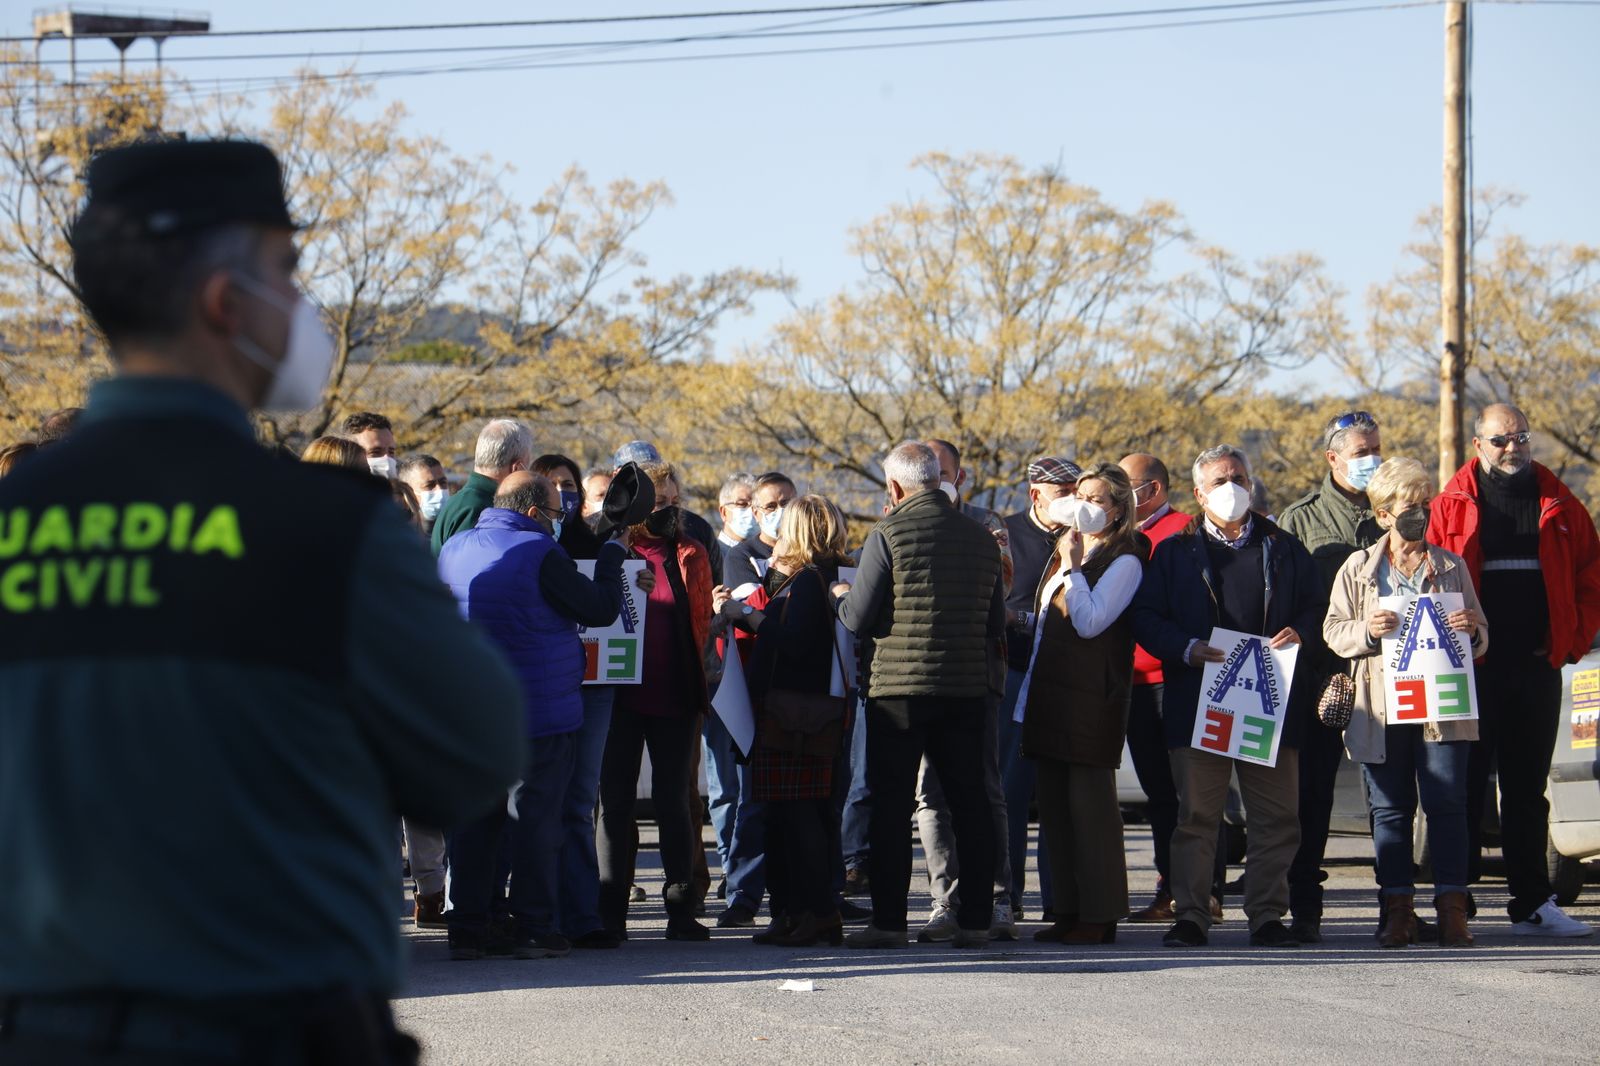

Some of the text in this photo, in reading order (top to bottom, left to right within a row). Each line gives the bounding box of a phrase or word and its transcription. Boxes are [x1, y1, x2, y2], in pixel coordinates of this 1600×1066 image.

[0, 502, 244, 558] UARDIA
[1, 556, 160, 613] CIVIL
[1390, 600, 1418, 668] PLATAFORMA
[1434, 601, 1467, 661] CIUDADANA
[1206, 638, 1249, 699] PLATAFORMA
[1262, 645, 1281, 709] CIUDADANA
[1206, 703, 1235, 714] REVUELTA
